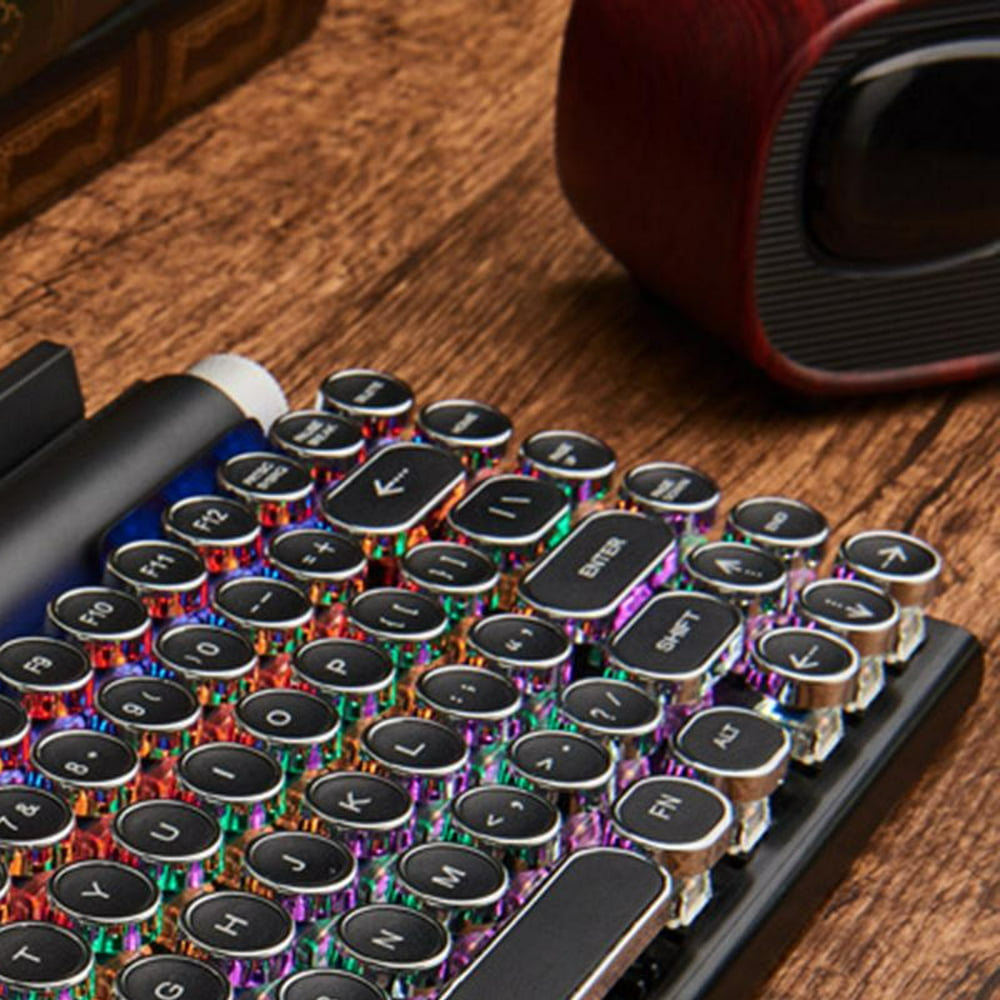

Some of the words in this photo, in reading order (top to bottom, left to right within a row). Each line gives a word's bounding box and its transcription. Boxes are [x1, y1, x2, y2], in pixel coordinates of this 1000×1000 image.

[192, 508, 230, 533] F12
[139, 553, 176, 579] F11
[577, 536, 628, 580] ENTER
[78, 601, 115, 627] F10
[655, 610, 700, 653] SHIFT
[23, 656, 53, 674] F9
[325, 658, 347, 675] P
[713, 723, 740, 749] ALT
[394, 743, 426, 757] L
[338, 791, 371, 813] K
[648, 793, 682, 820] FN
[150, 822, 180, 842] U
[282, 854, 306, 872] J
[431, 865, 466, 889] M
[81, 881, 110, 899] Y
[214, 913, 248, 936] H
[371, 928, 404, 950] N
[12, 945, 41, 963] T
[154, 981, 184, 1000] G
